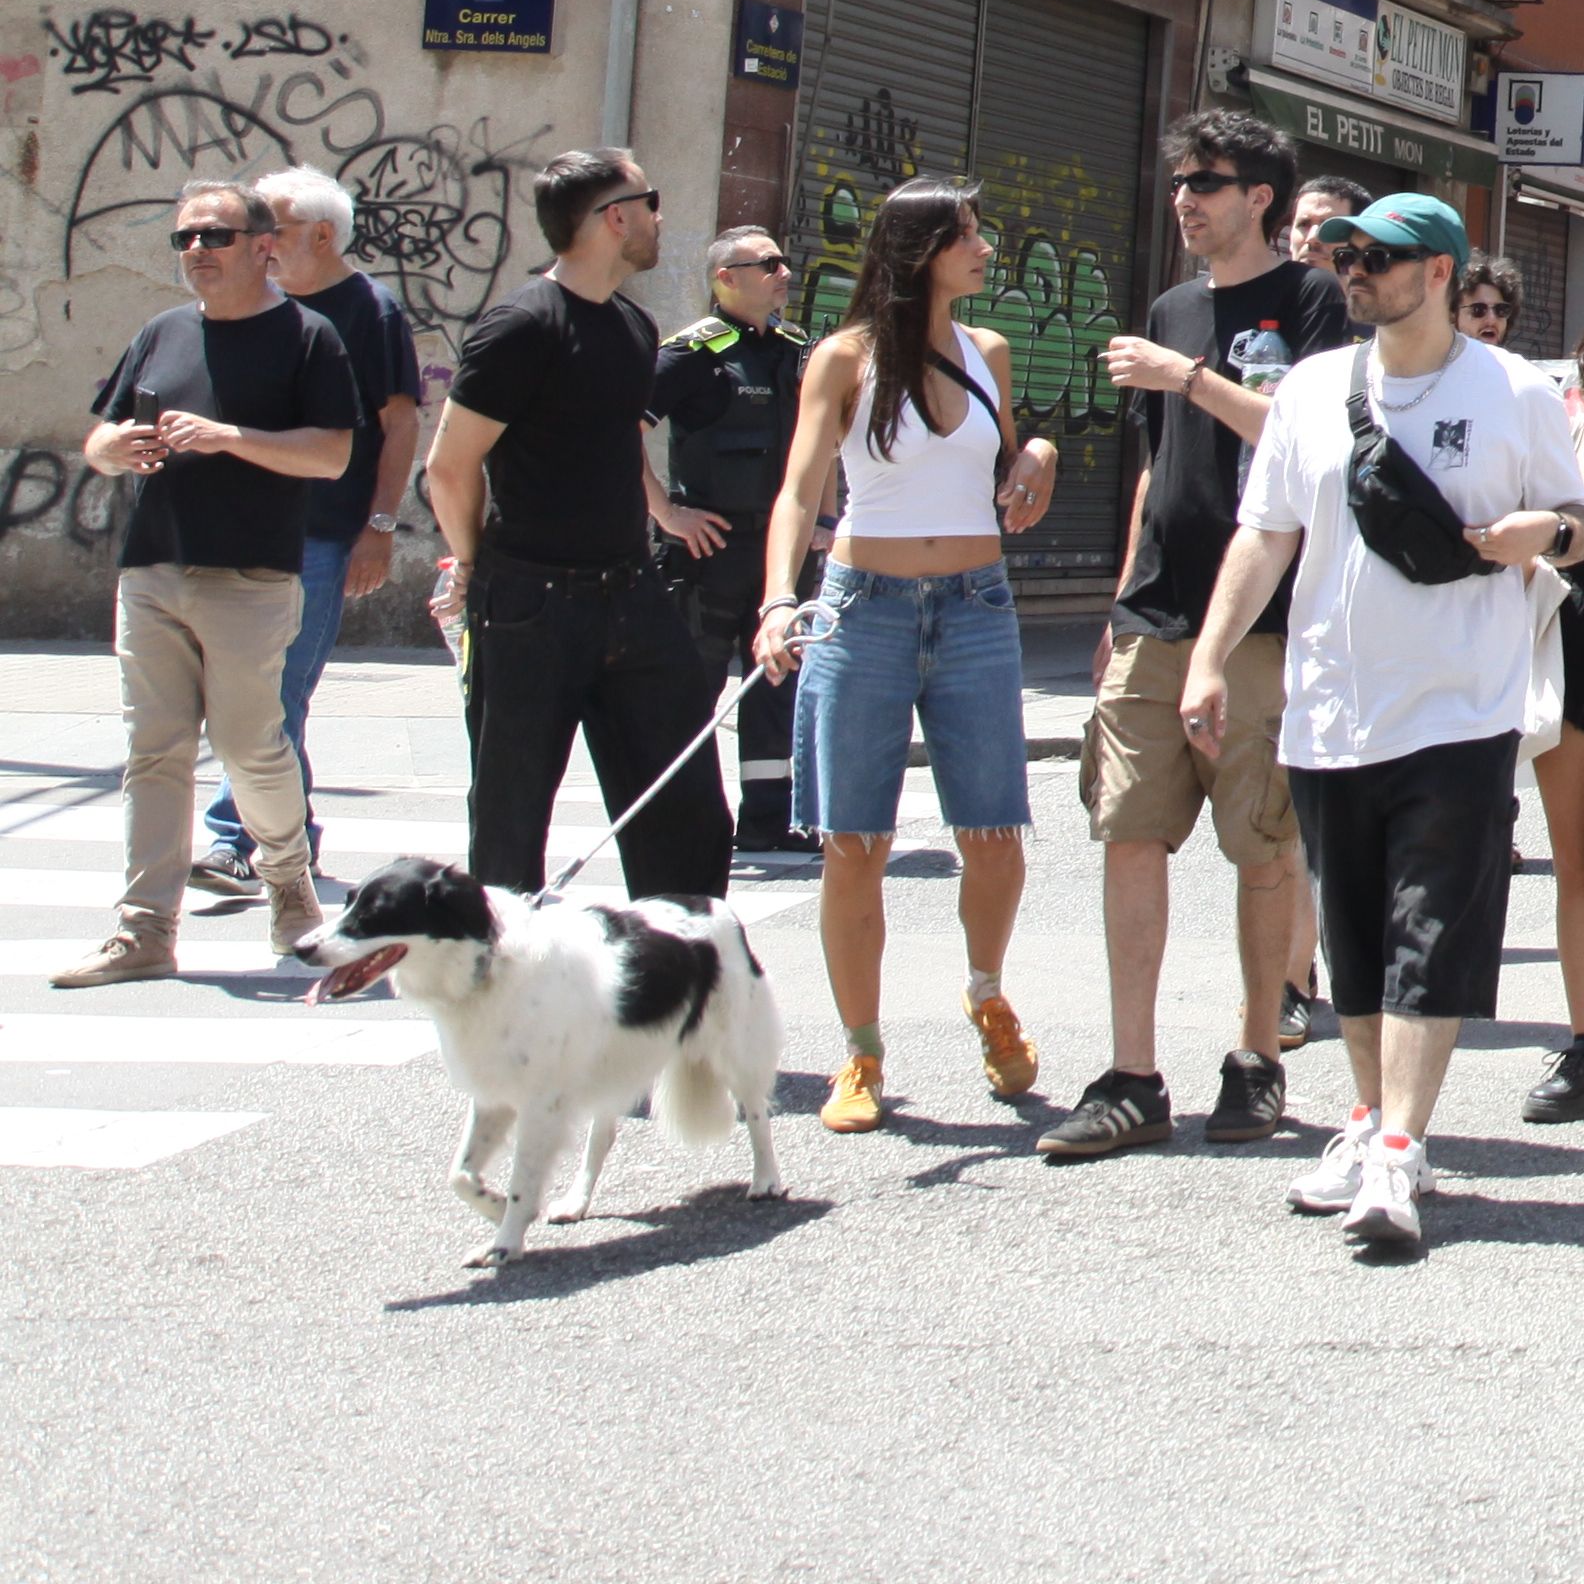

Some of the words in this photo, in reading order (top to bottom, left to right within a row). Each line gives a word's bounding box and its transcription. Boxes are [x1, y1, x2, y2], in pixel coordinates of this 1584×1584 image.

[458, 8, 516, 25] Carrer
[425, 29, 452, 44] Ntra.
[455, 30, 478, 44] Sra.
[481, 31, 504, 45] dels
[507, 32, 546, 49] Angels
[1391, 13, 1404, 64] EL
[1406, 18, 1437, 75] PETIT
[785, 49, 798, 64] de
[1392, 68, 1424, 98] OBJECTES
[1424, 78, 1434, 102] DE
[1435, 82, 1455, 109] REGAL
[1306, 105, 1329, 140] EL
[1336, 114, 1384, 155] PETIT
[1394, 137, 1424, 165] MON
[1507, 127, 1542, 136] Loterías
[1544, 128, 1550, 138] y
[1506, 137, 1547, 148] Apuestas
[1549, 137, 1563, 147] del
[1506, 147, 1535, 157] Estado
